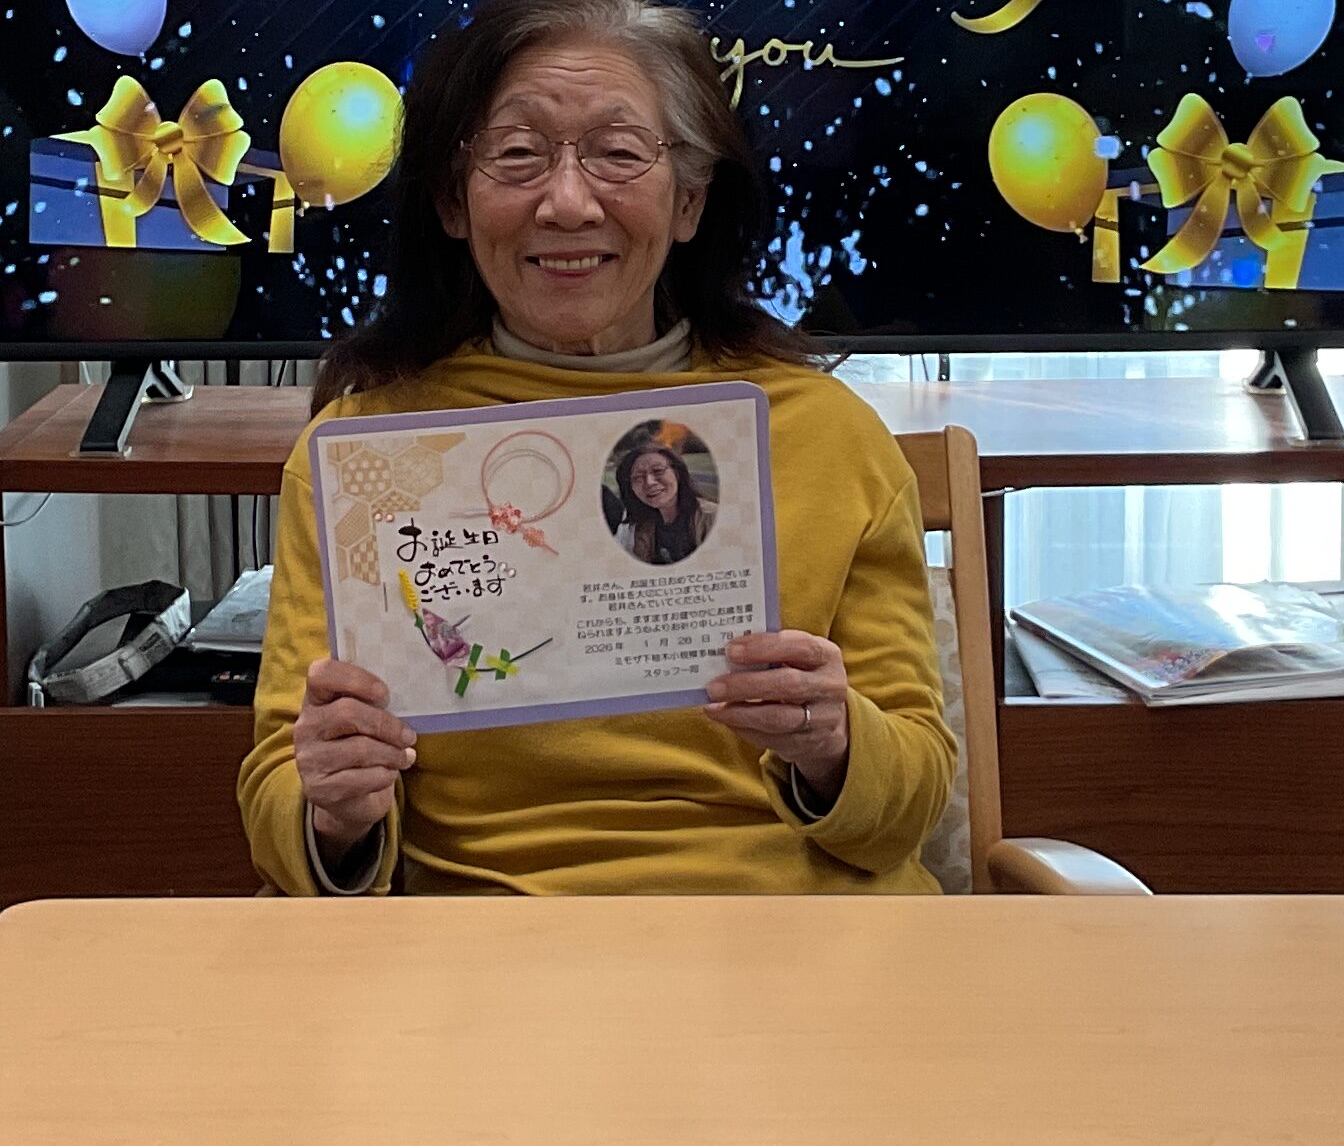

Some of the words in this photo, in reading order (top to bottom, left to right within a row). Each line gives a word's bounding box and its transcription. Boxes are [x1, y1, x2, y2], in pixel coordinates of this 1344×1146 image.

[710, 37, 905, 110] you
[397, 517, 499, 563] お誕生日
[414, 554, 497, 587] おめでとう
[421, 573, 506, 603] ございます
